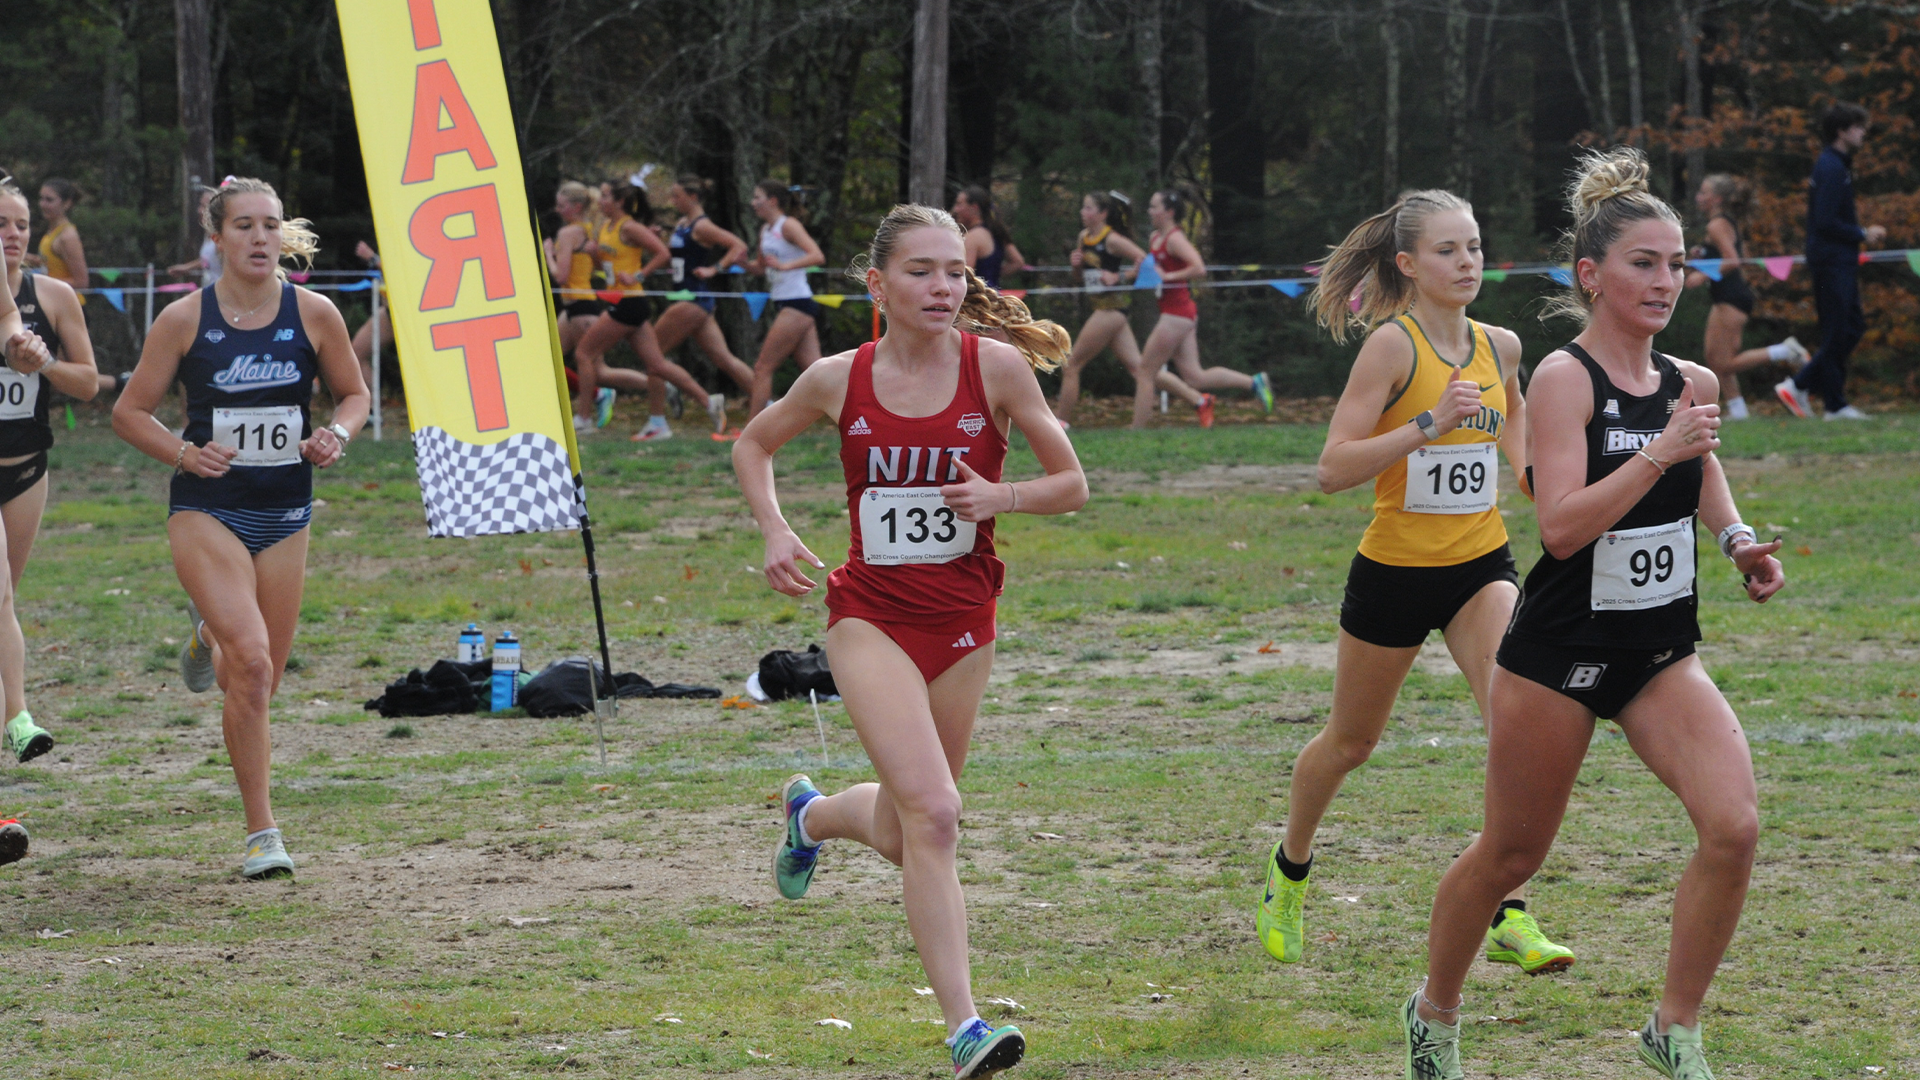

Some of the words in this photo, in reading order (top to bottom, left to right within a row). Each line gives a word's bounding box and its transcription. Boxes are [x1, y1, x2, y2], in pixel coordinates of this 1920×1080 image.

[273, 328, 294, 341] NB
[213, 353, 301, 385] Maine
[232, 423, 288, 450] 116
[868, 446, 970, 486] NJIT
[1427, 461, 1485, 495] 169
[881, 507, 956, 544] 133
[1630, 545, 1673, 587] 99
[1567, 666, 1601, 688] B
